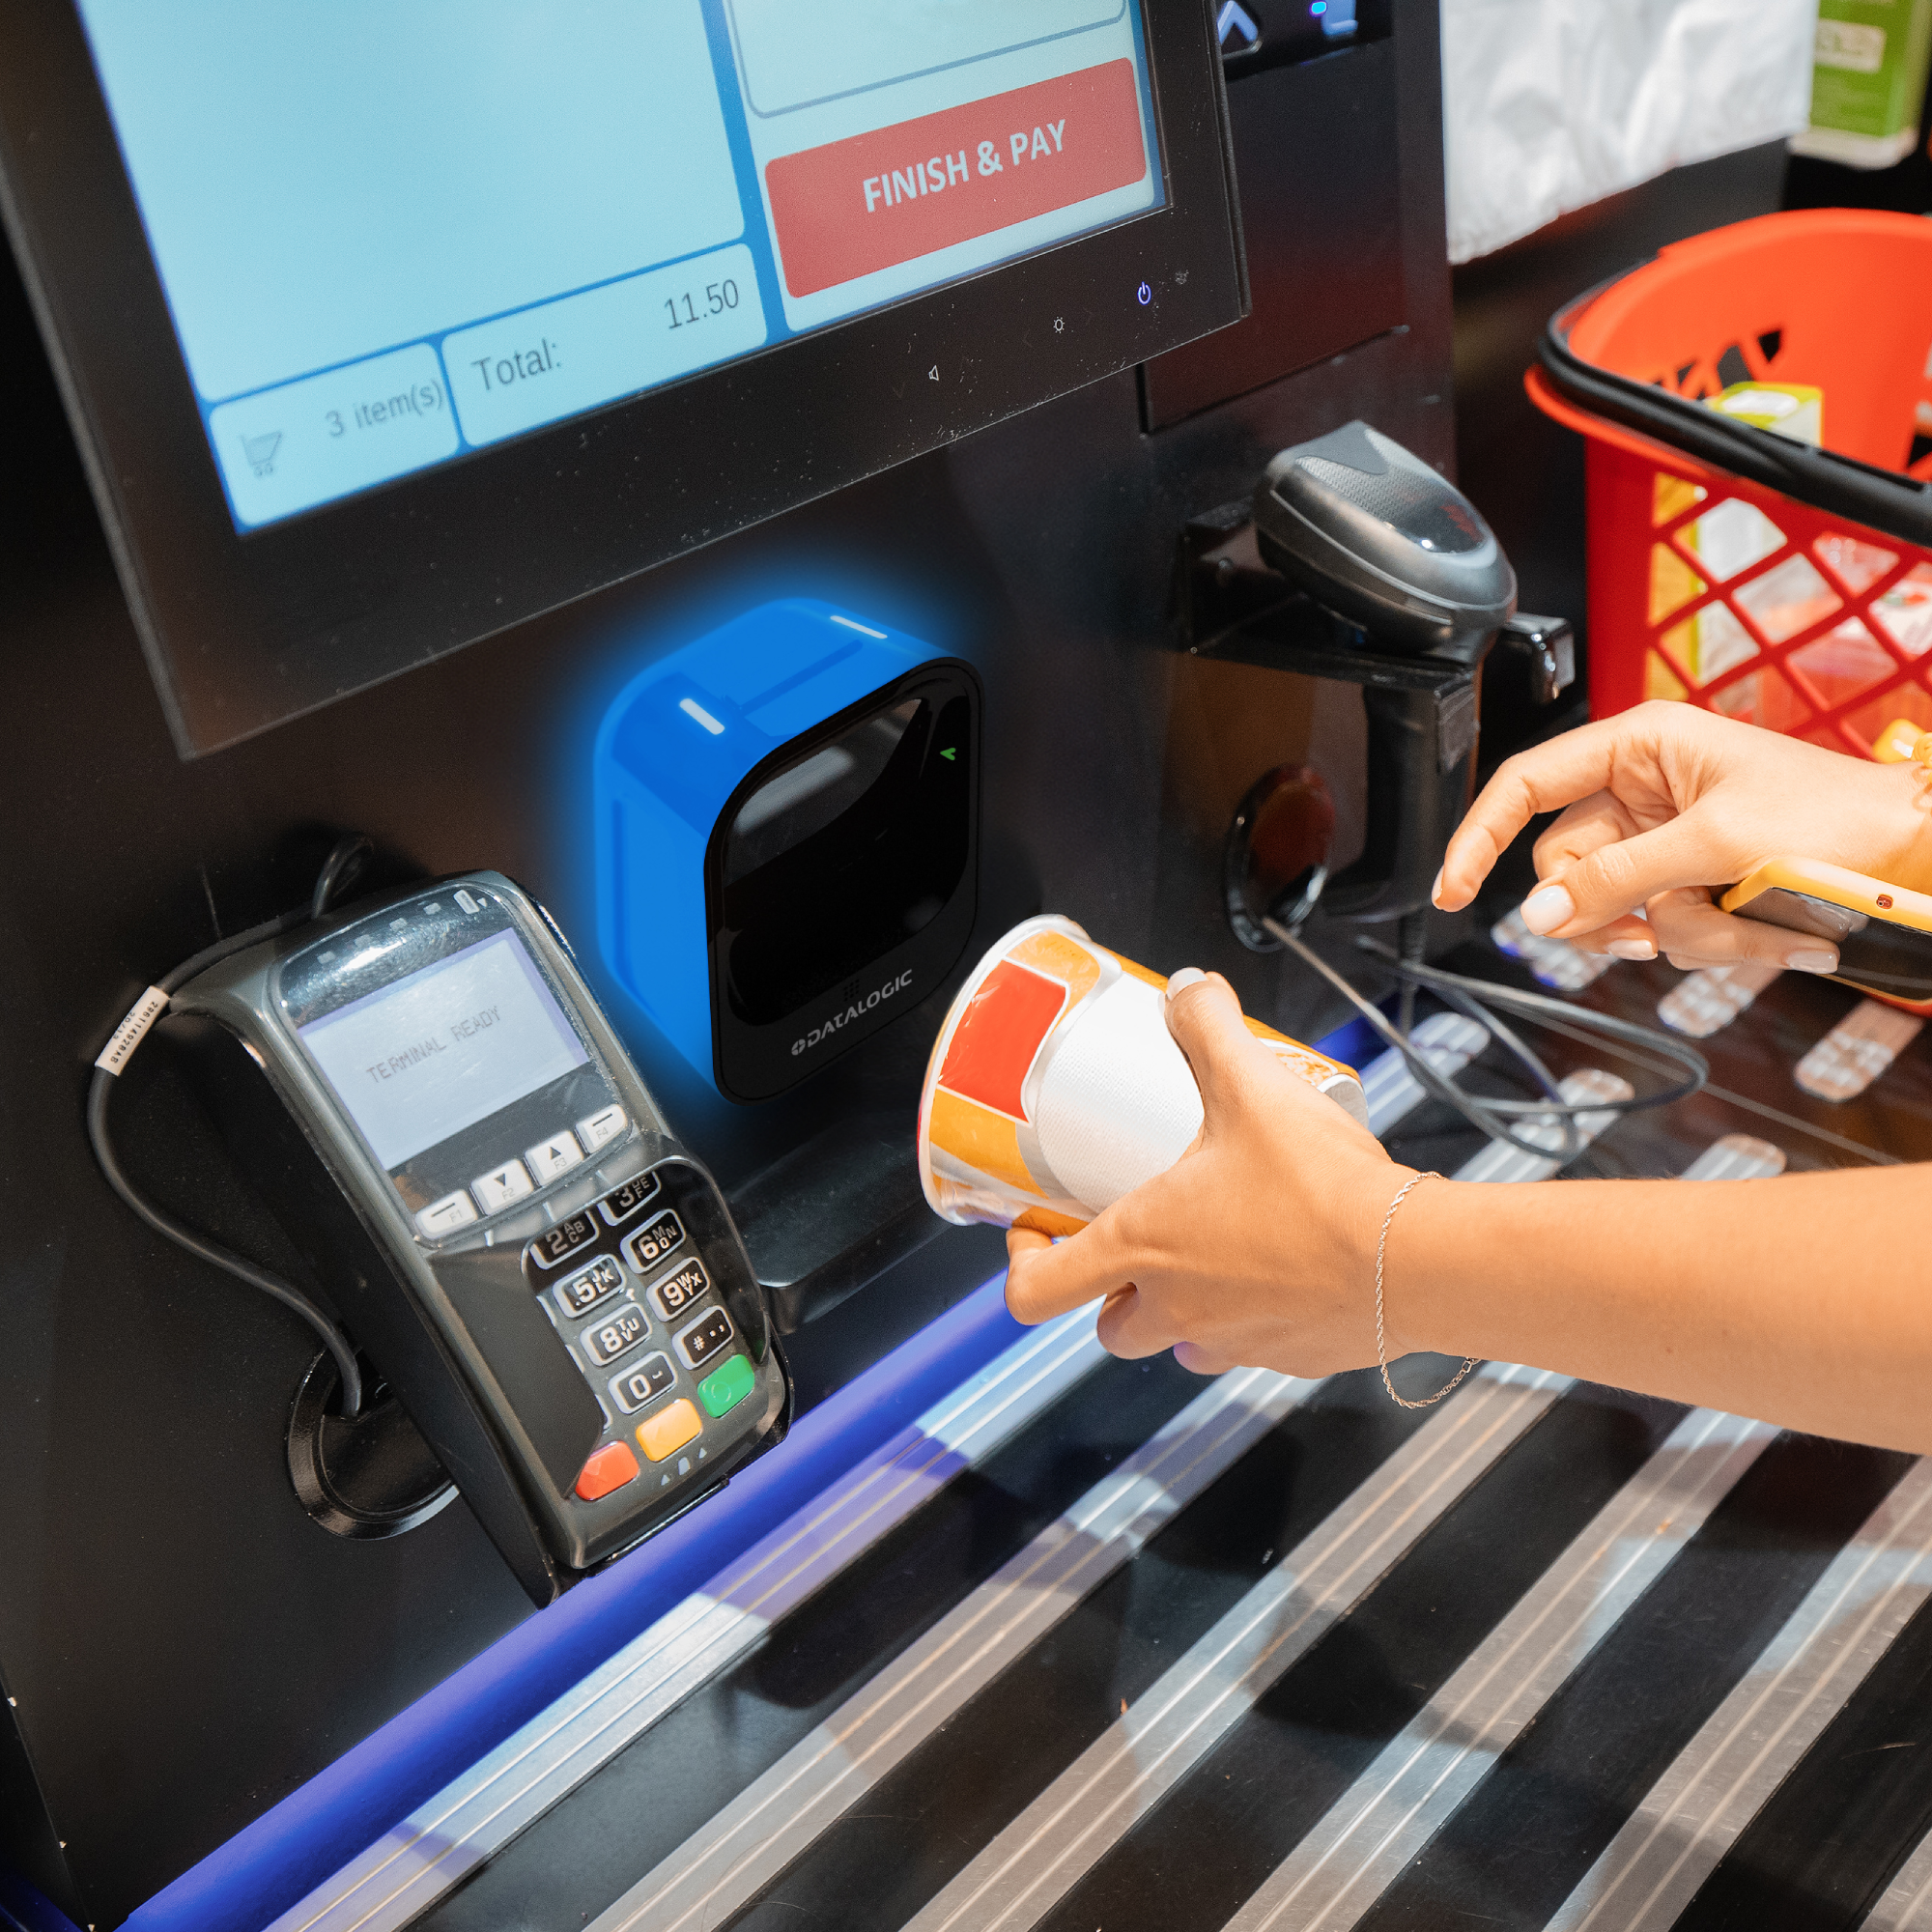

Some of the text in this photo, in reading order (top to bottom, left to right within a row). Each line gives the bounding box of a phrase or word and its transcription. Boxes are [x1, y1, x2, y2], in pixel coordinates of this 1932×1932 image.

[863, 119, 1065, 213] FINISH & PAY
[469, 278, 740, 391] Total: 11.50
[325, 379, 443, 438] 3 item(s)
[807, 968, 913, 1048] DATALOGIC
[365, 1005, 500, 1083] TERMINAL READY
[595, 1126, 610, 1140] F4
[554, 1157, 568, 1171] F3
[500, 1187, 516, 1201] F2
[448, 1209, 464, 1224] F1
[546, 1229, 568, 1255] 2
[638, 1235, 660, 1260] 6
[572, 1276, 597, 1303] 5
[663, 1281, 685, 1306] 9
[599, 1325, 623, 1352] 8
